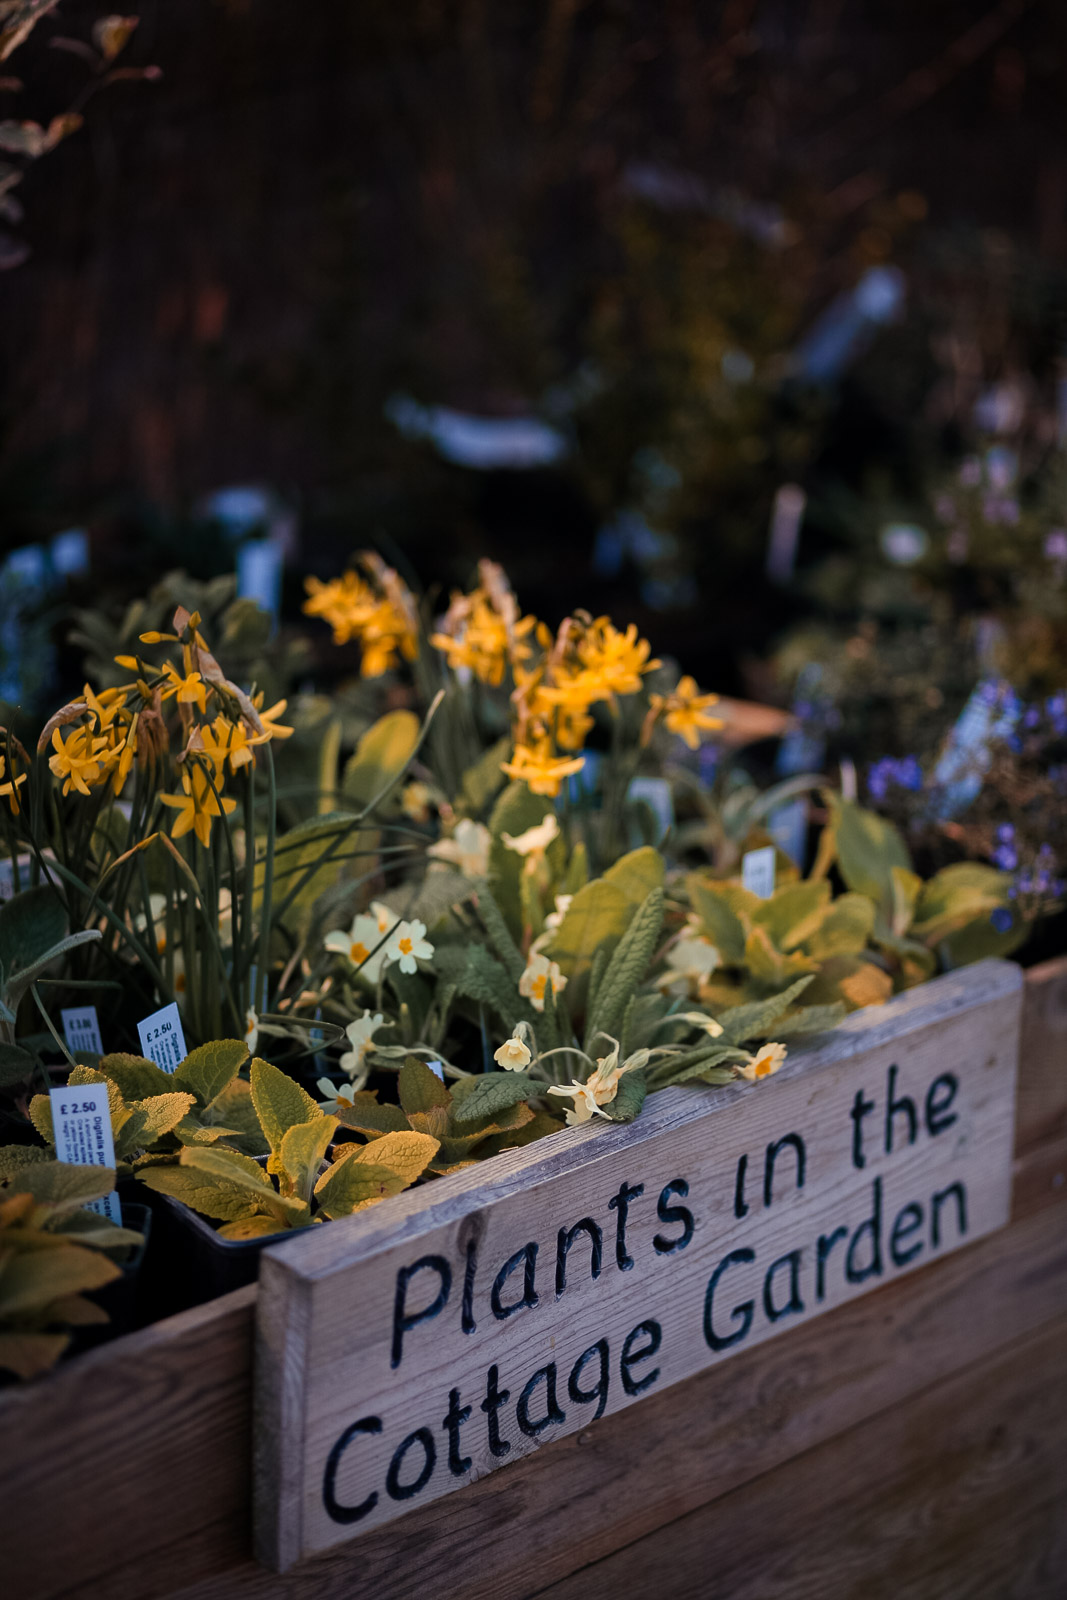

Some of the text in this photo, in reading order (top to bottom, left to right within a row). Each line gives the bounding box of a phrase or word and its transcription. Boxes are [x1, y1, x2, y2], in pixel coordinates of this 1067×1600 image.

[153, 1022, 172, 1039] 2.50
[61, 1101, 96, 1115] £ 2.50
[93, 1116, 105, 1150] Digitalis
[390, 1063, 959, 1370] Plants in the
[322, 1175, 968, 1525] Cottage Garden
